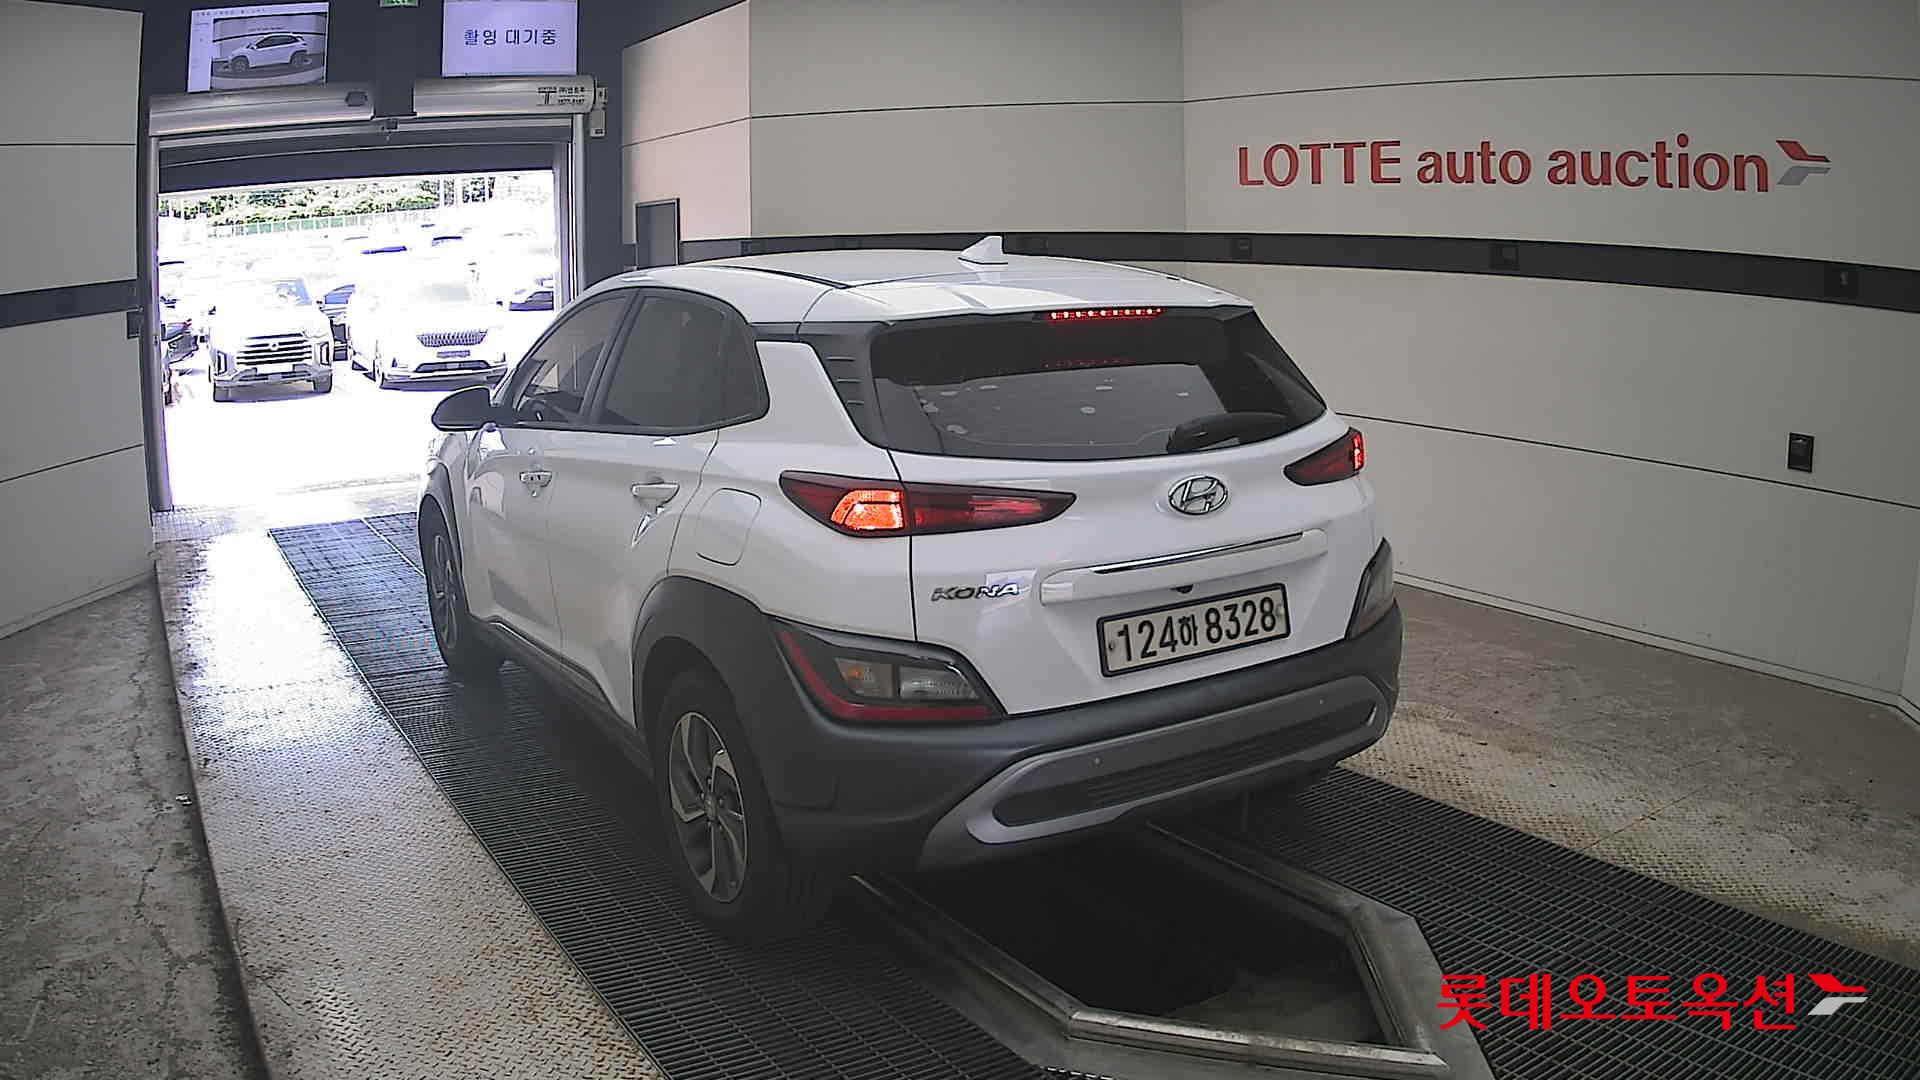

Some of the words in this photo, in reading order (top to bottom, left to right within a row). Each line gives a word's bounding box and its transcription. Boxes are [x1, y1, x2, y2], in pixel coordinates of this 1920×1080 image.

[464, 29, 497, 45] 촬영
[505, 29, 556, 45] 대기중
[1238, 140, 1401, 187] LOTTE
[1416, 140, 1531, 185] auto
[1547, 132, 1769, 193] auction
[930, 582, 1020, 602] KONA
